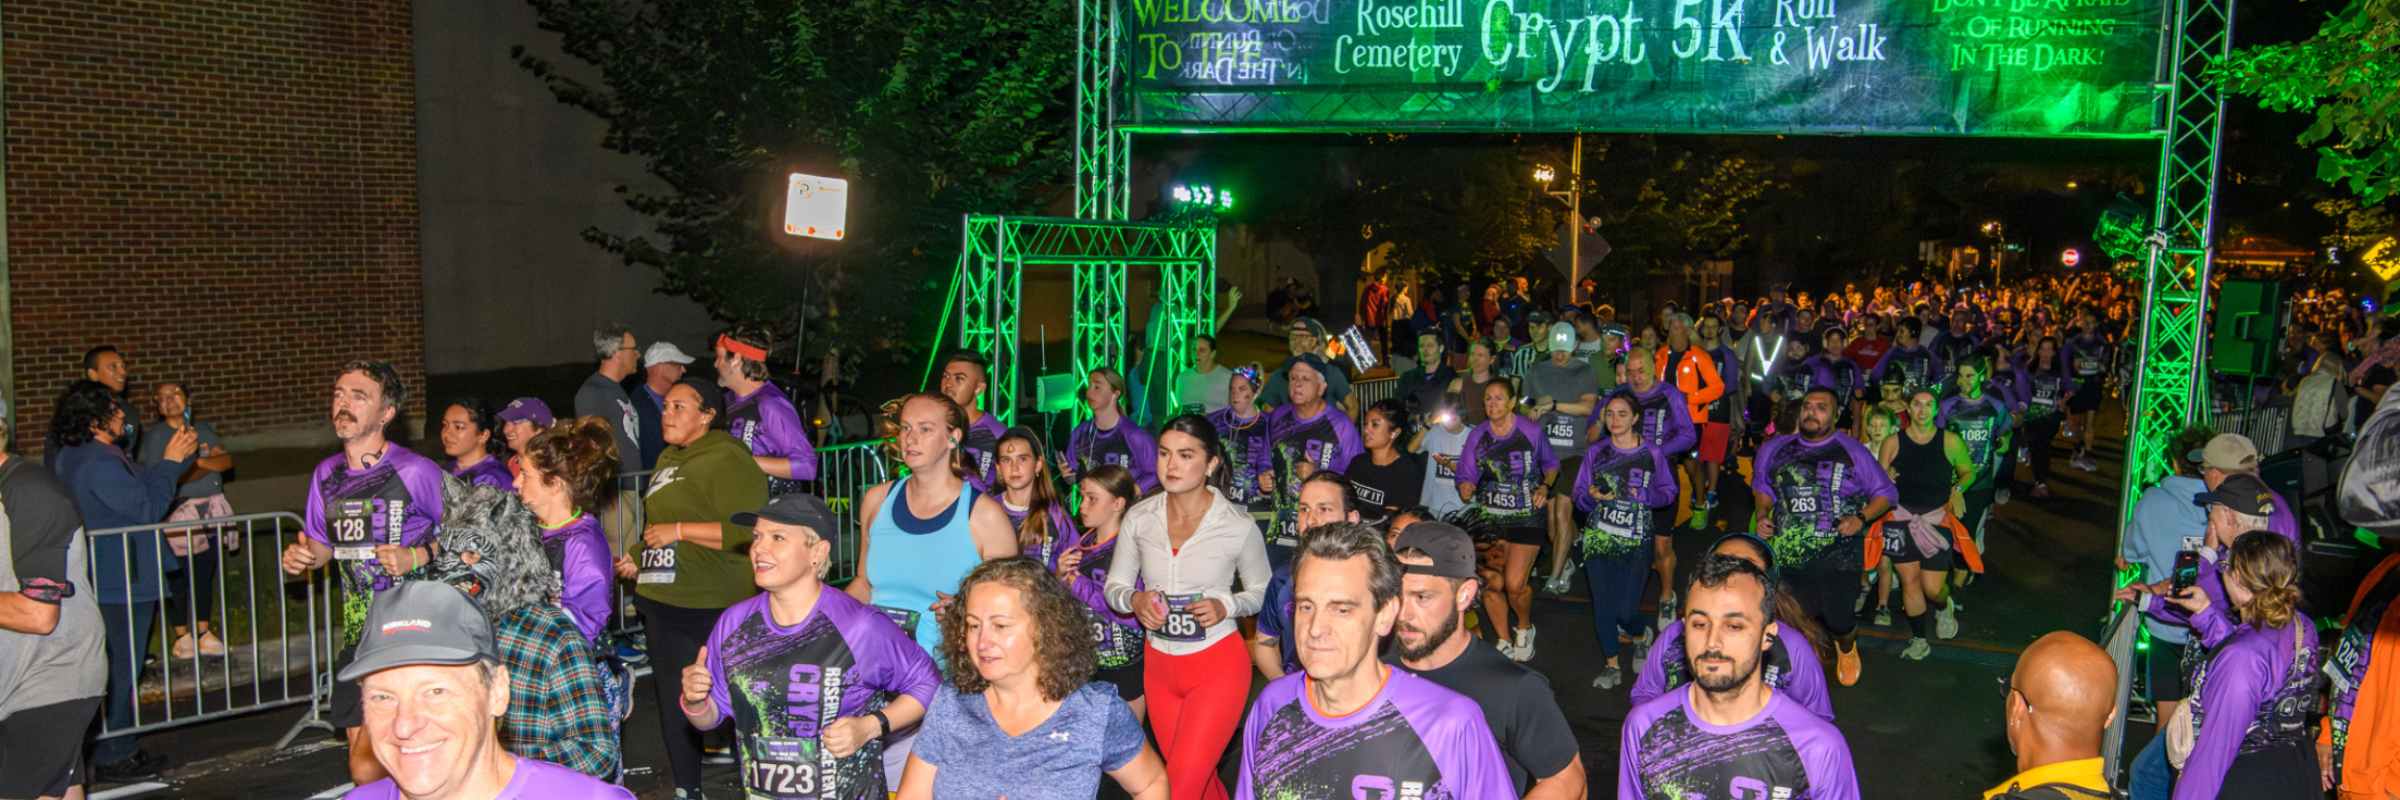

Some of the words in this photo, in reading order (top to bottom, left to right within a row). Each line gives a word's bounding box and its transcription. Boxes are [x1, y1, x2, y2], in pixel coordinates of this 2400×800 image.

[1133, 0, 1300, 27] WELCOME
[1356, 0, 1464, 36] Rosehill
[2007, 15, 2116, 40] RUNNING
[1138, 33, 1182, 80] TO
[1334, 34, 1463, 76] Cemetery
[1481, 0, 1646, 92] Crypt
[1672, 0, 1753, 61] 5K
[1769, 31, 1790, 65] &
[1804, 23, 1887, 70] Walk
[1951, 43, 1977, 72] IN
[1981, 43, 2028, 72] THE
[2032, 43, 2105, 72] DARK!
[1546, 423, 1574, 438] 1455
[1960, 429, 1989, 442] 1082
[1487, 491, 1516, 508] 1453
[1790, 496, 1817, 513] 263
[333, 518, 365, 541] 128
[1602, 506, 1635, 527] 1454
[641, 547, 675, 569] 1738
[2335, 636, 2360, 676] 1242
[751, 759, 815, 794] 1723
